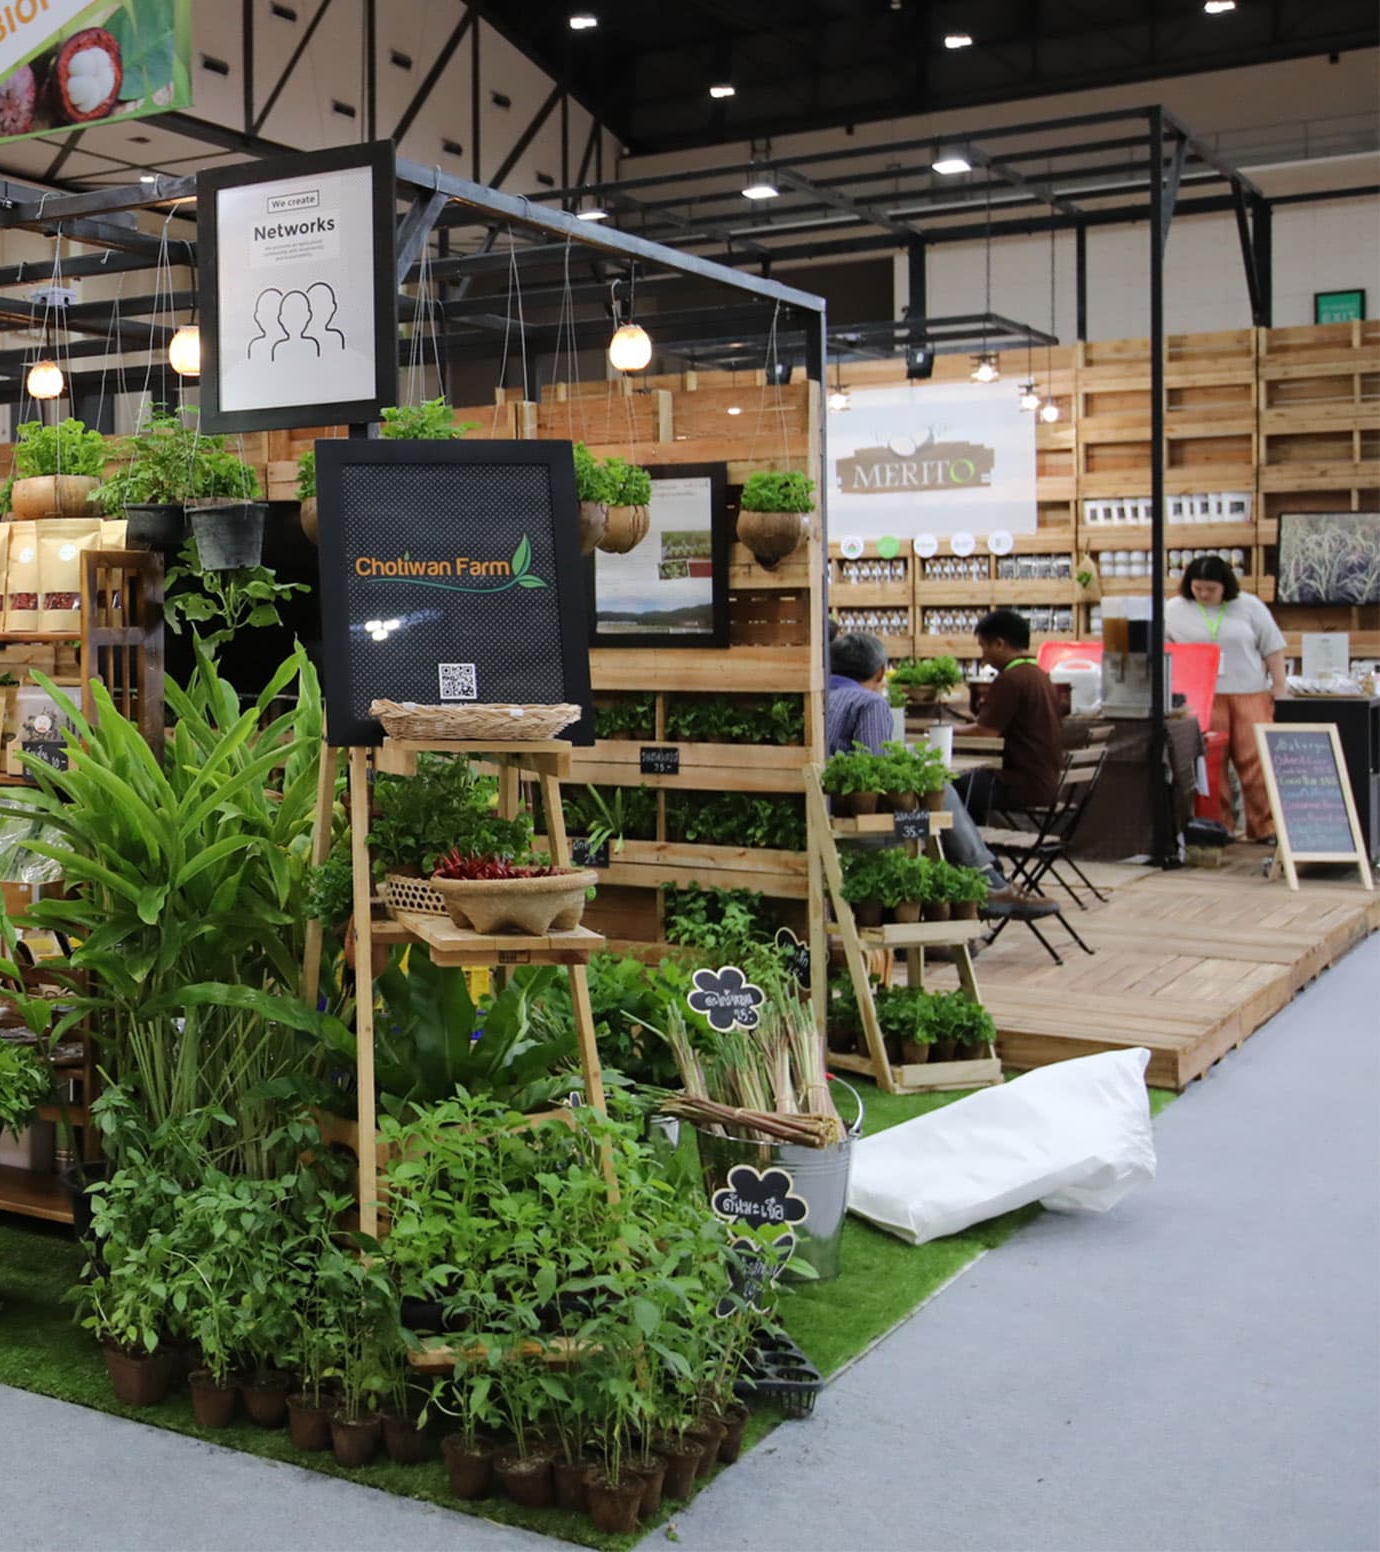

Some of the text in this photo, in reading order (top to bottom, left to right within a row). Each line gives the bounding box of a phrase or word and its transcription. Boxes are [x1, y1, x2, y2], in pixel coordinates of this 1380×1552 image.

[271, 196, 315, 208] We create
[254, 217, 335, 241] Networks
[852, 458, 975, 489] MERITO
[355, 553, 510, 577] Chotiwan Farm
